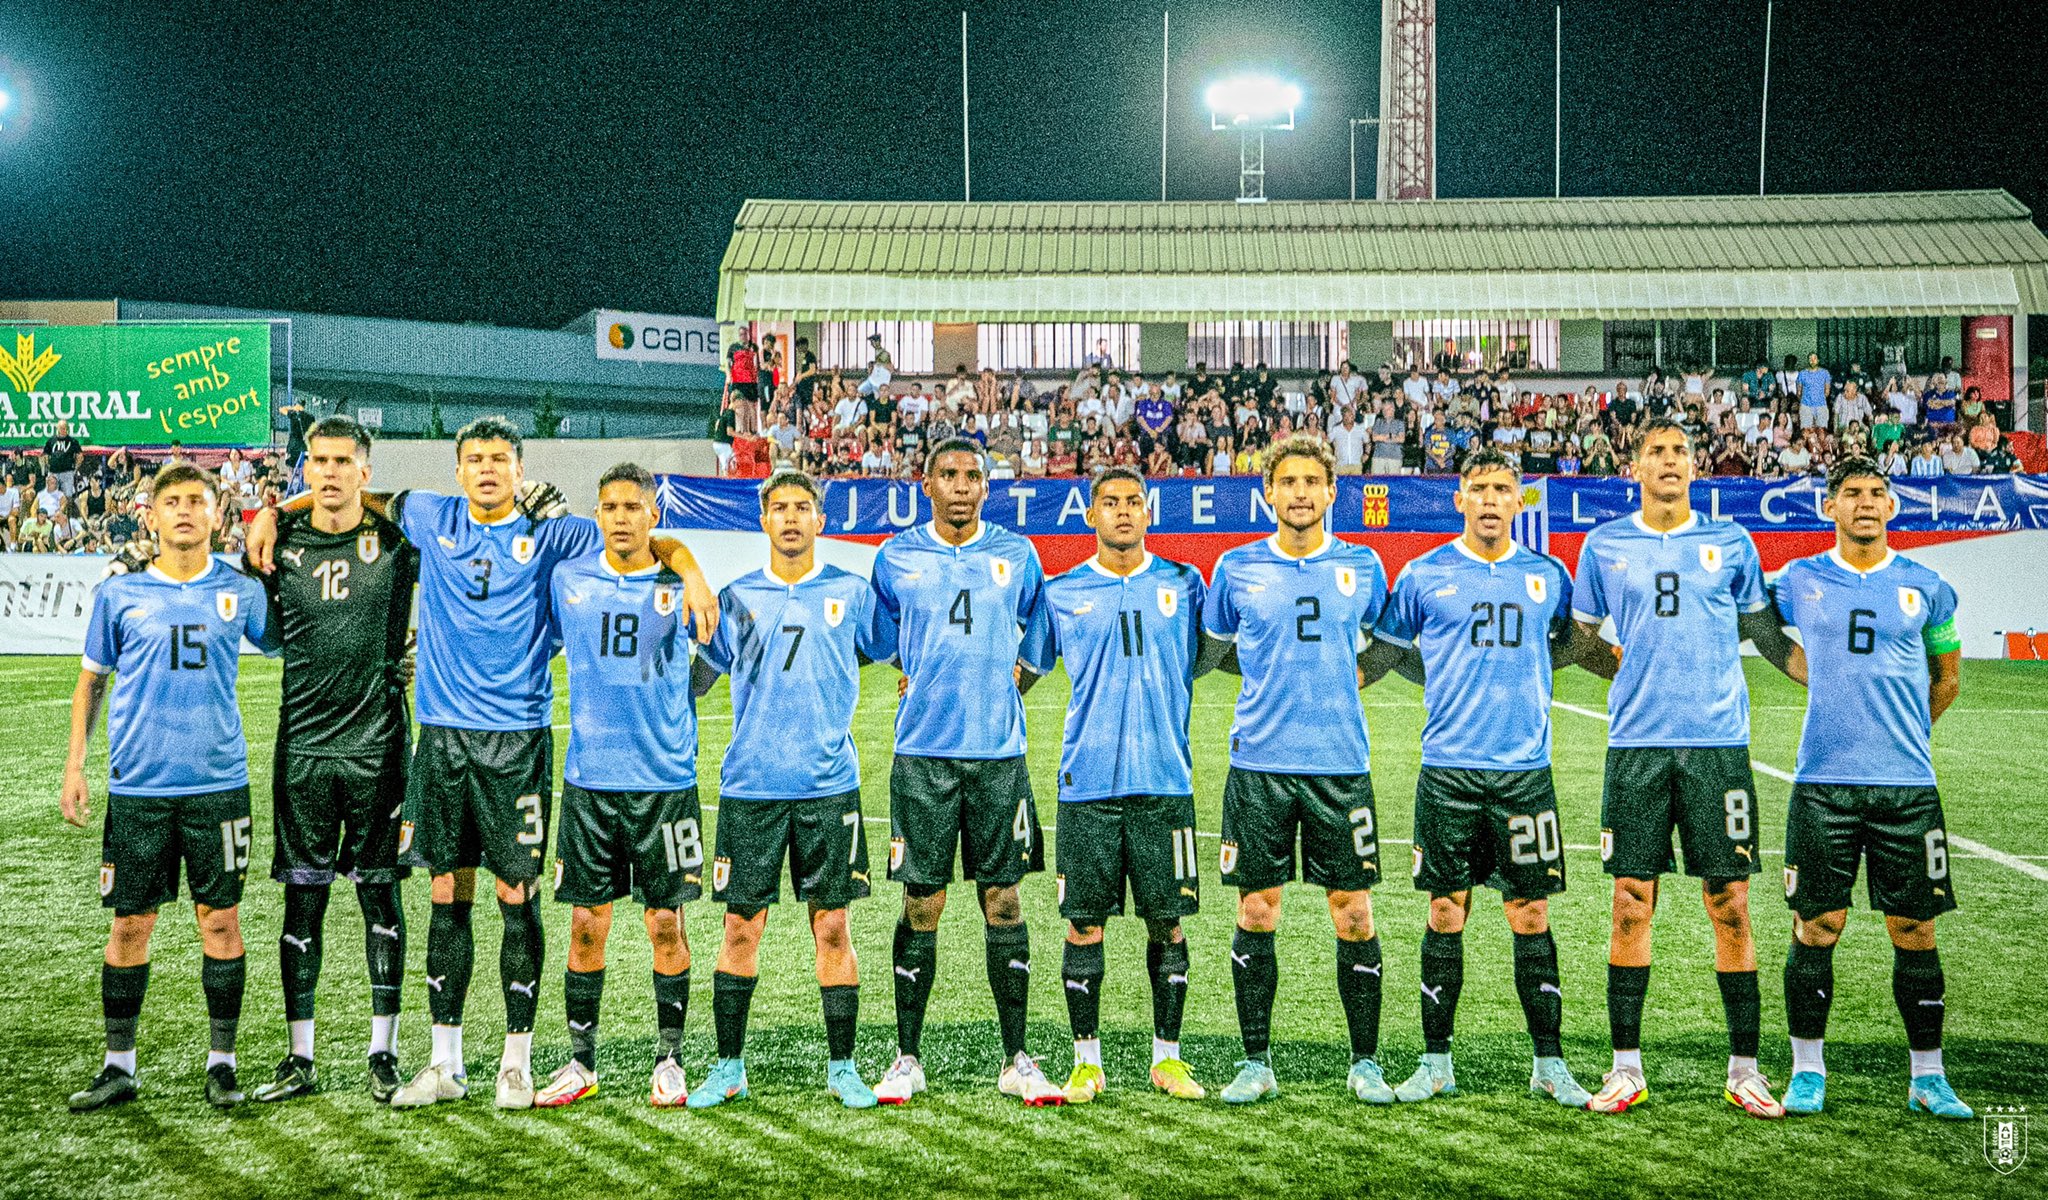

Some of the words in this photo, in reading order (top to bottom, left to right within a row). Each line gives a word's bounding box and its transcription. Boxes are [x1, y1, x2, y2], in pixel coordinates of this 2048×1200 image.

[147, 337, 240, 379] sempre
[642, 326, 719, 353] cans
[27, 390, 151, 420] RURAL
[174, 363, 230, 400] amb
[0, 420, 90, 438] 'ALCÚIA
[160, 386, 261, 434] l'esport
[312, 558, 350, 600] 12
[466, 558, 492, 601] 3
[1655, 572, 1680, 618] 8
[600, 610, 639, 658] 18
[948, 588, 974, 635] 4
[1119, 609, 1143, 658] 11
[1296, 596, 1322, 642] 2
[1470, 602, 1524, 648] 20
[1848, 608, 1877, 656] 6
[170, 624, 208, 670] 15
[781, 624, 806, 671] 7
[516, 793, 544, 845] 3
[843, 811, 860, 865] 7
[1012, 798, 1031, 848] 4
[1349, 807, 1376, 856] 2
[1508, 810, 1560, 865] 20
[1724, 789, 1751, 840] 8
[220, 816, 250, 872] 15
[661, 818, 704, 873] 18
[1172, 826, 1197, 880] 11
[1924, 828, 1947, 880] 6
